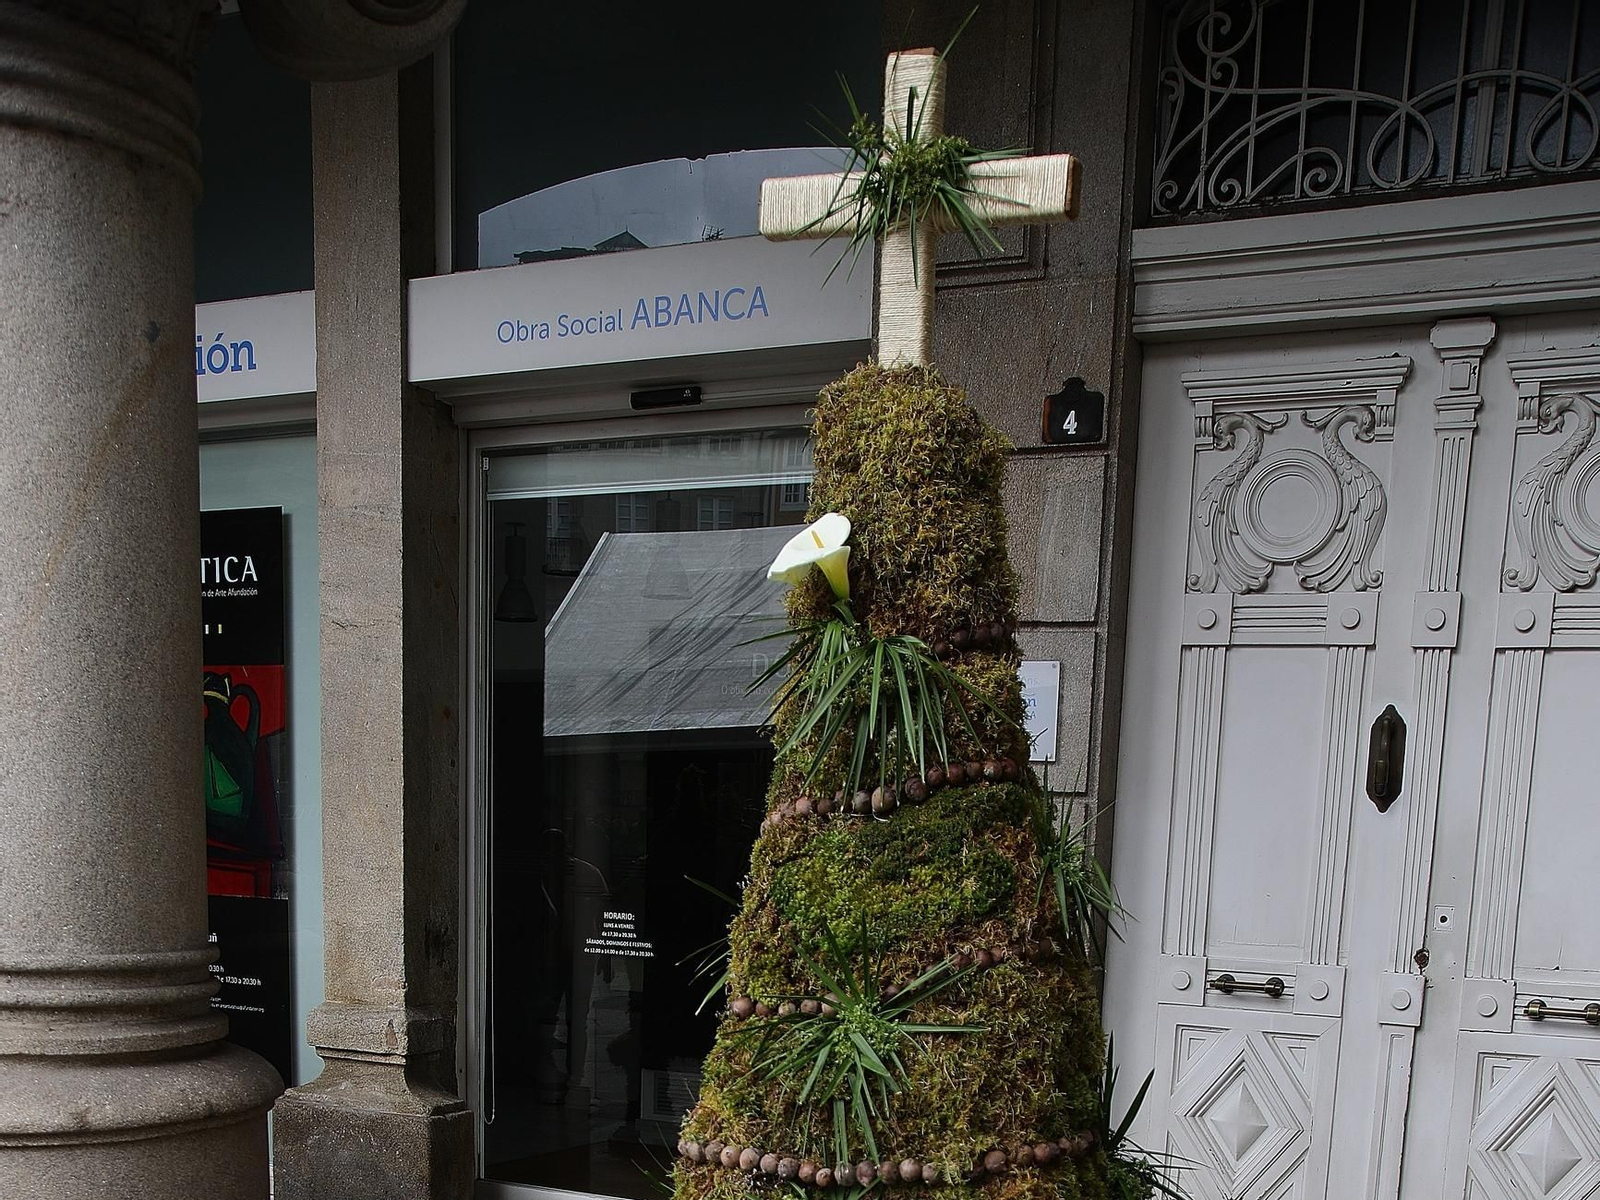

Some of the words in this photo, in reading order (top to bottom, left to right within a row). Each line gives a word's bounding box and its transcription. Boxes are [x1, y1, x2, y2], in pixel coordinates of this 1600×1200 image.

[497, 320, 550, 343] Obra
[557, 309, 623, 337] Social
[630, 285, 769, 330] ABANCA
[195, 332, 257, 375] ión
[1063, 410, 1077, 434] 4
[603, 911, 635, 921] HORARIO:
